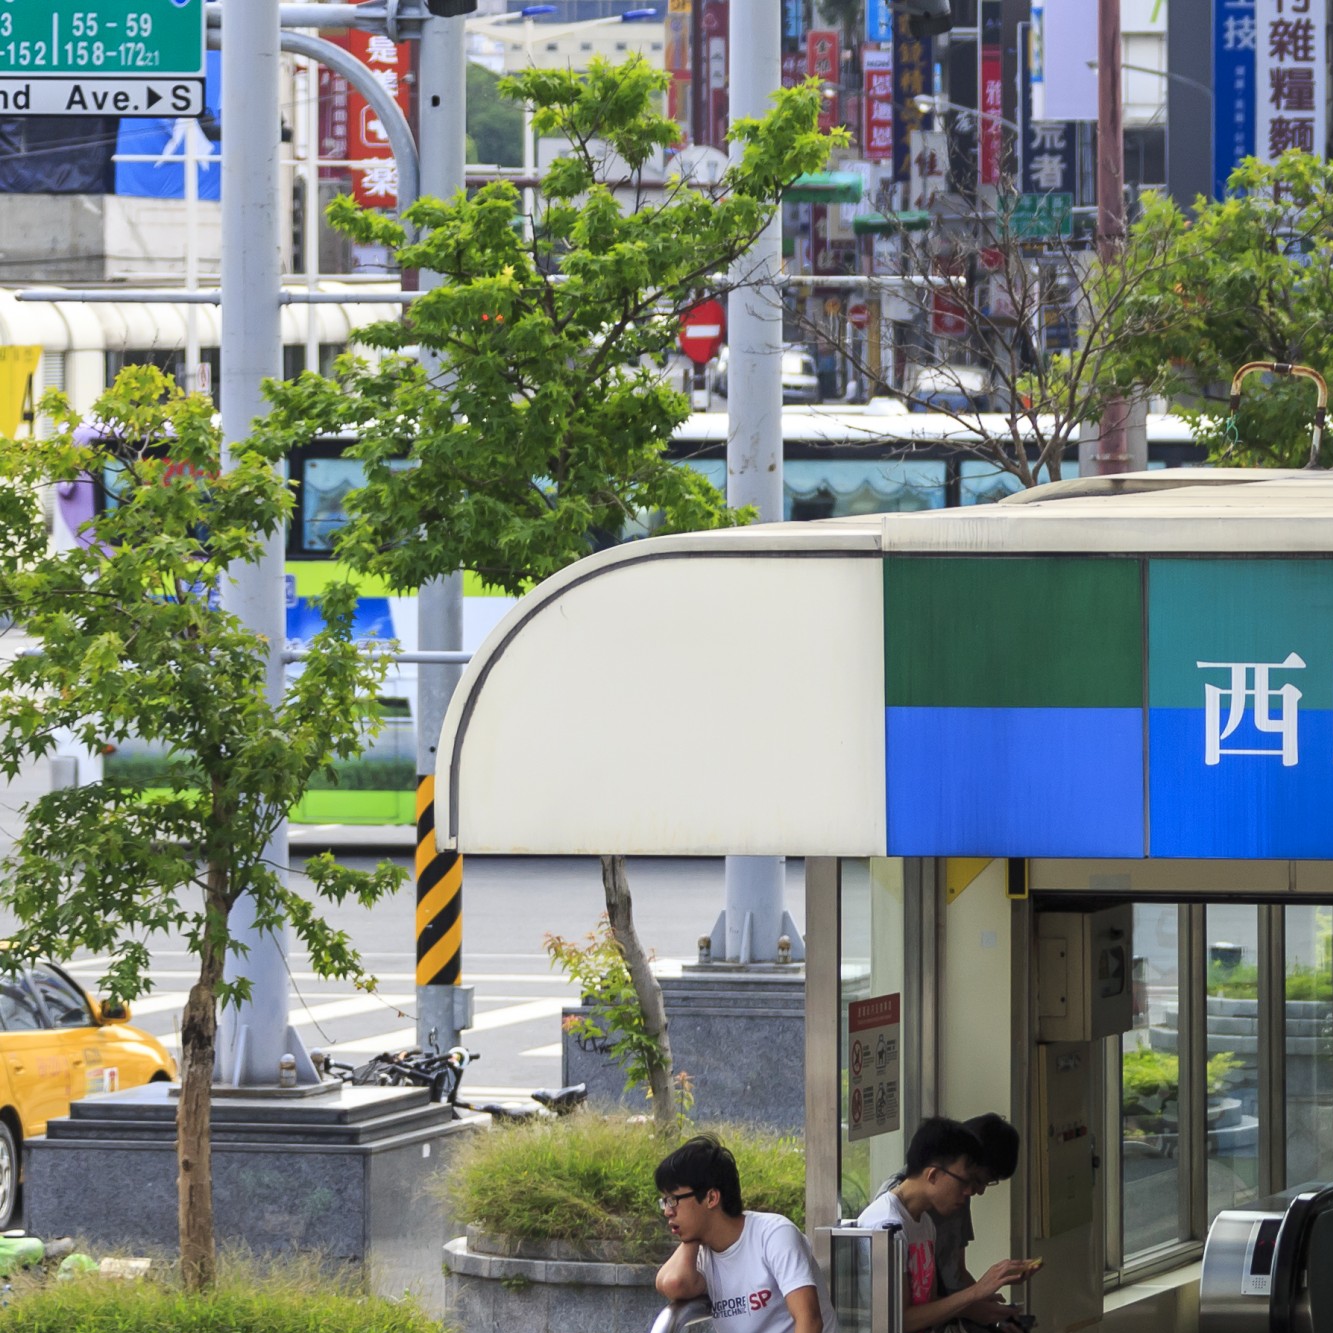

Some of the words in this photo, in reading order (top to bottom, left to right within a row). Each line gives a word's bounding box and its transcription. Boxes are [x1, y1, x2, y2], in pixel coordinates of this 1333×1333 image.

[71, 12, 99, 37] 55
[125, 12, 152, 37] 59
[66, 84, 139, 111] Ave.
[170, 84, 192, 111] S
[748, 1289, 772, 1311] SP
